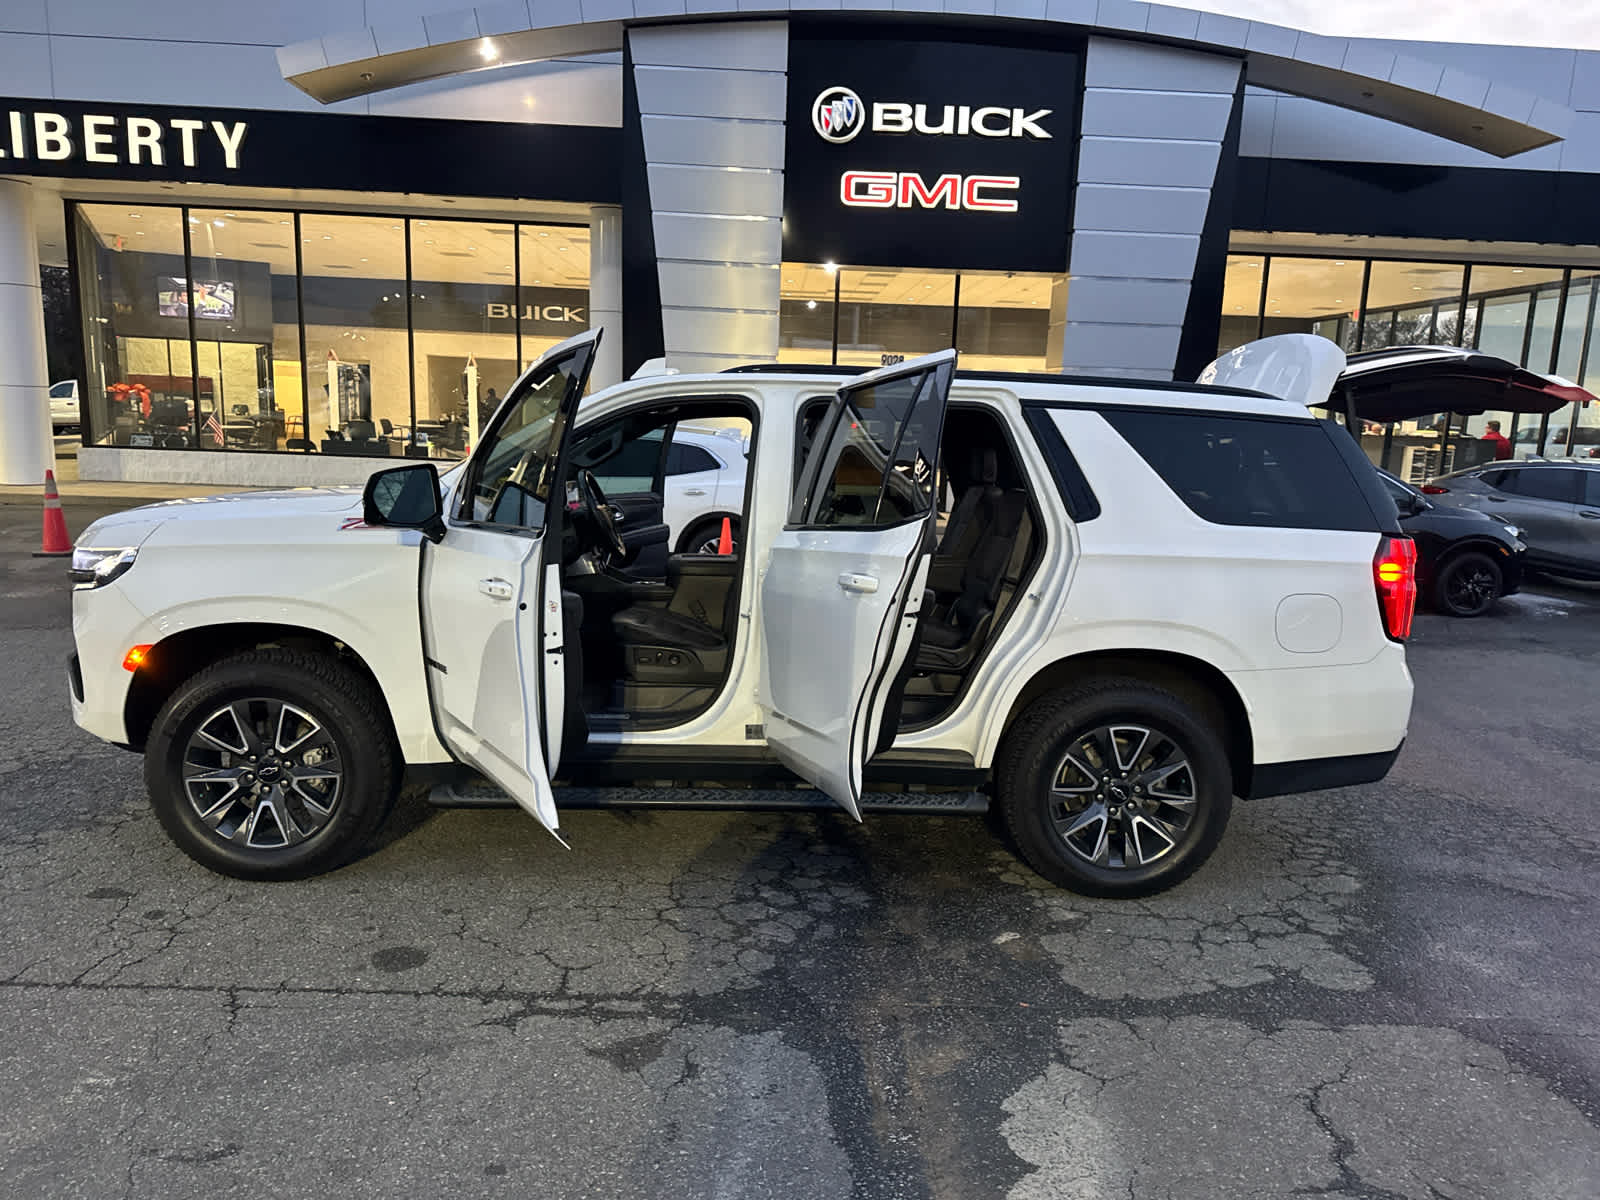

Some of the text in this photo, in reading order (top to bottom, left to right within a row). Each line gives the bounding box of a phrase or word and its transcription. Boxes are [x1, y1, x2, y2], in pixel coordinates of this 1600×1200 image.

[0, 111, 247, 169] IBERTY
[872, 102, 1053, 139] BUICK
[840, 170, 1020, 212] GMC
[487, 303, 585, 323] BUICK
